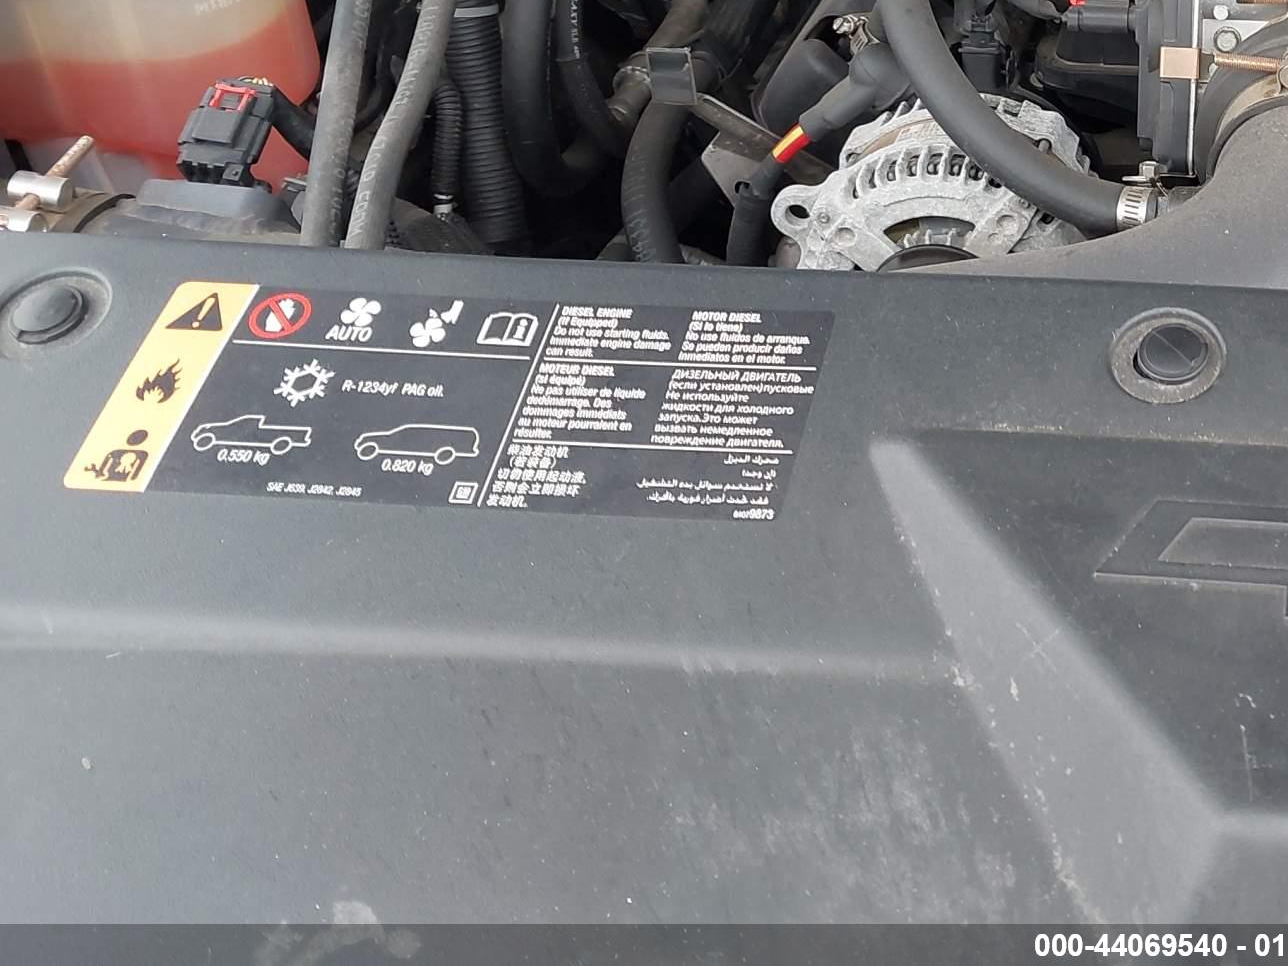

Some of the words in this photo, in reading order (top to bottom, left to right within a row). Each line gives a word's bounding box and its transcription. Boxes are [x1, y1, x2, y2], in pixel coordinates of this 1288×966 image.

[561, 306, 594, 317] DIESEL
[596, 307, 633, 319] ENGINE
[692, 310, 728, 322] MOTOR
[728, 312, 762, 323] DIESEL
[570, 317, 618, 328] Equipped)
[704, 322, 714, 331] lo
[715, 322, 743, 333] tiene)
[325, 324, 373, 342] AUTO
[553, 326, 567, 336] Do
[568, 327, 584, 336] not
[585, 328, 603, 338] use
[603, 328, 640, 341] starting
[641, 329, 669, 340] fluids.
[685, 331, 699, 341] No
[700, 332, 718, 342] use
[719, 332, 751, 343] fluidos
[752, 333, 765, 343] de
[766, 335, 810, 346] arranque.
[549, 335, 599, 348] Immediate
[600, 338, 632, 350] engine
[633, 340, 671, 352] damage
[681, 341, 694, 351] Se
[695, 342, 731, 353] pueden
[732, 343, 773, 354] producir
[773, 344, 803, 354] daños
[545, 347, 563, 356] can
[564, 347, 593, 358] result.
[731, 354, 745, 363] en
[745, 353, 756, 363] el
[756, 354, 785, 364] motor.
[539, 363, 580, 375] MOTEUR
[581, 365, 615, 377] DIESEL
[672, 368, 739, 381] ДИЗЕЛЬНЫЙ
[740, 371, 802, 383] ДВИГАТЕЛЬ
[341, 379, 399, 396] R-1234yf
[401, 382, 426, 397] PAG
[530, 384, 543, 395] Ne
[545, 386, 564, 396] pas
[565, 386, 599, 397] utiliser
[599, 387, 613, 397] de
[613, 387, 647, 400] liquide
[668, 380, 697, 391] (если
[592, 397, 613, 409] Des
[665, 390, 679, 400] Не
[682, 392, 750, 403] используйте
[522, 406, 575, 418] dommages
[661, 402, 714, 413] жидкости
[714, 404, 735, 414] для
[736, 405, 794, 416] холодного
[518, 417, 531, 427] au
[532, 417, 567, 428] moteur
[567, 419, 618, 431] pourraient
[619, 422, 633, 431] en
[723, 416, 759, 425] может
[654, 423, 698, 434] вызвать
[699, 425, 774, 437] немедленное
[650, 435, 725, 447] повреждение
[725, 437, 784, 448] двигателя.
[217, 448, 253, 463] 0.550
[253, 450, 271, 466] kg
[507, 443, 569, 459] 柴油发动机
[381, 458, 416, 473] 0.820
[417, 460, 434, 475] kg
[266, 481, 284, 492] SAE
